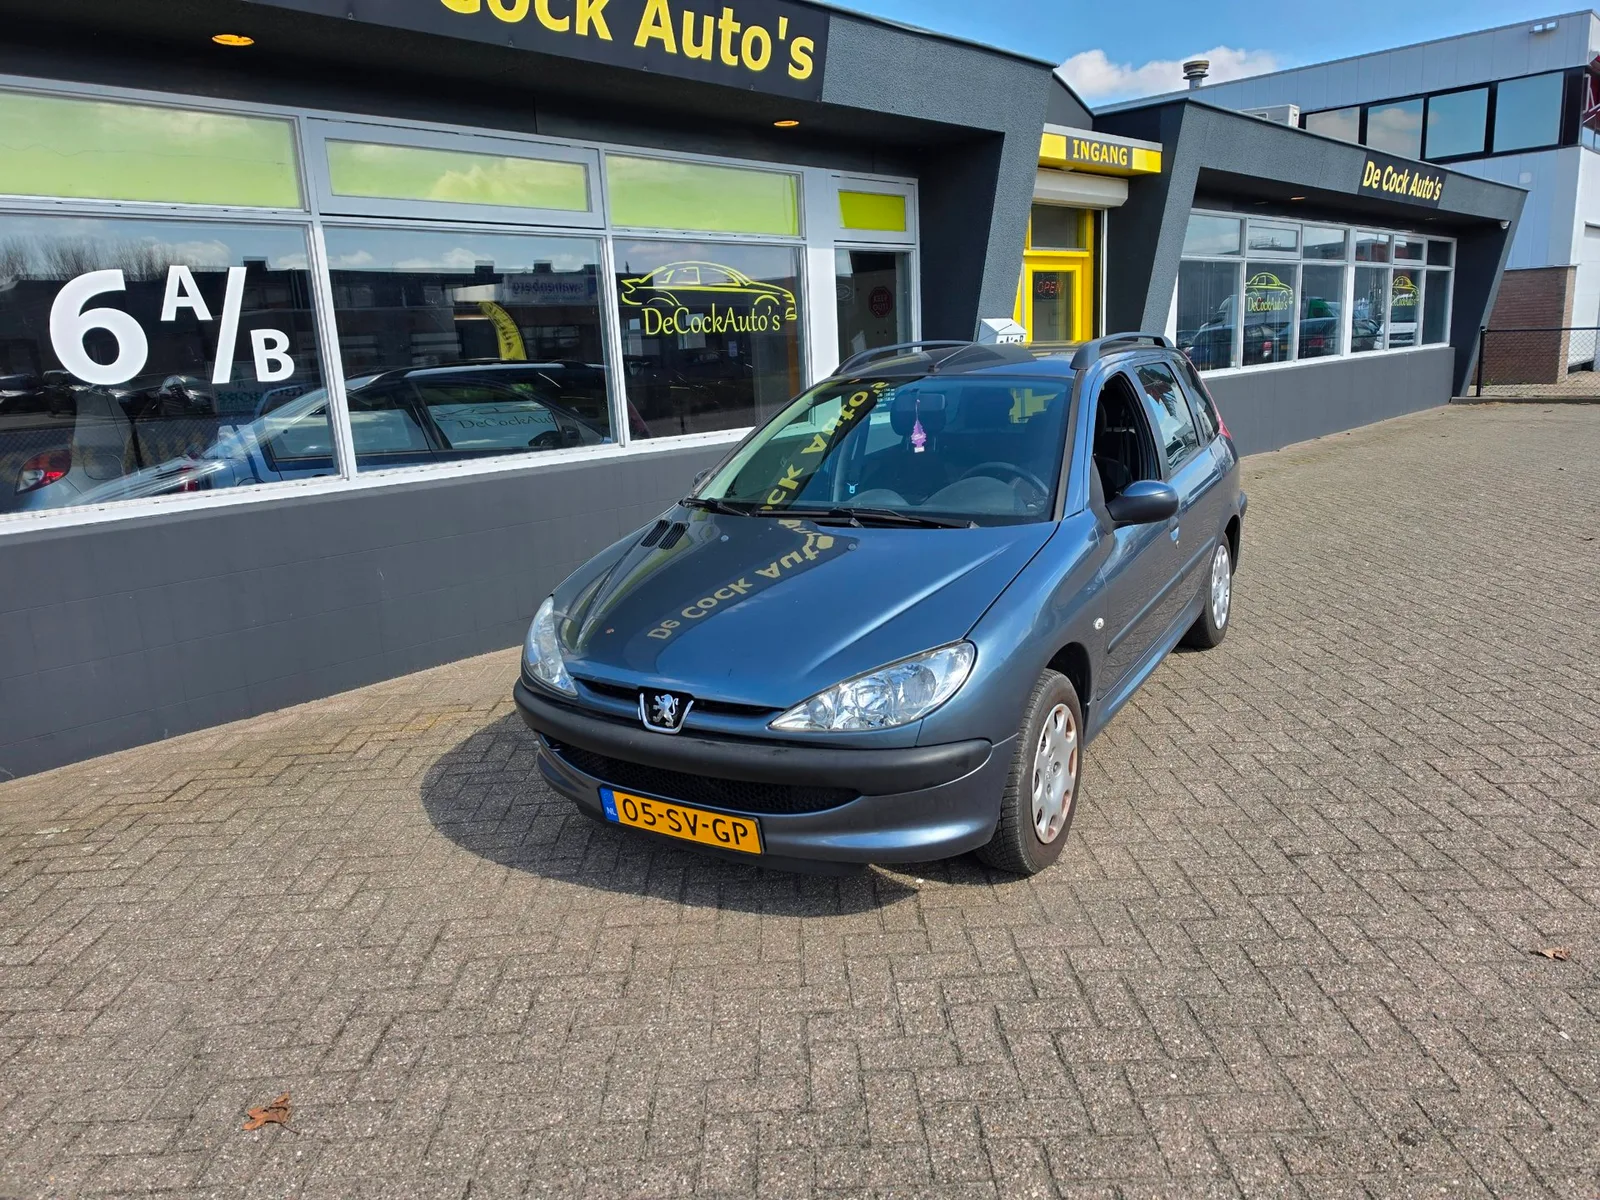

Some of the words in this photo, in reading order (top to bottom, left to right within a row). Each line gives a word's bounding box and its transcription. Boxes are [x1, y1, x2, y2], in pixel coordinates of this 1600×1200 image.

[440, 0, 612, 41] ock
[634, 0, 814, 80] Auto's
[1073, 139, 1128, 166] INGANG
[1362, 160, 1381, 189] De
[1382, 165, 1410, 195] Cock
[1408, 172, 1442, 201] Auto's
[1037, 280, 1064, 294] OPEN
[49, 269, 148, 385] 6
[641, 303, 781, 336] DeCockAuto's
[606, 806, 617, 816] NL
[622, 798, 748, 845] 05-SV-GP
